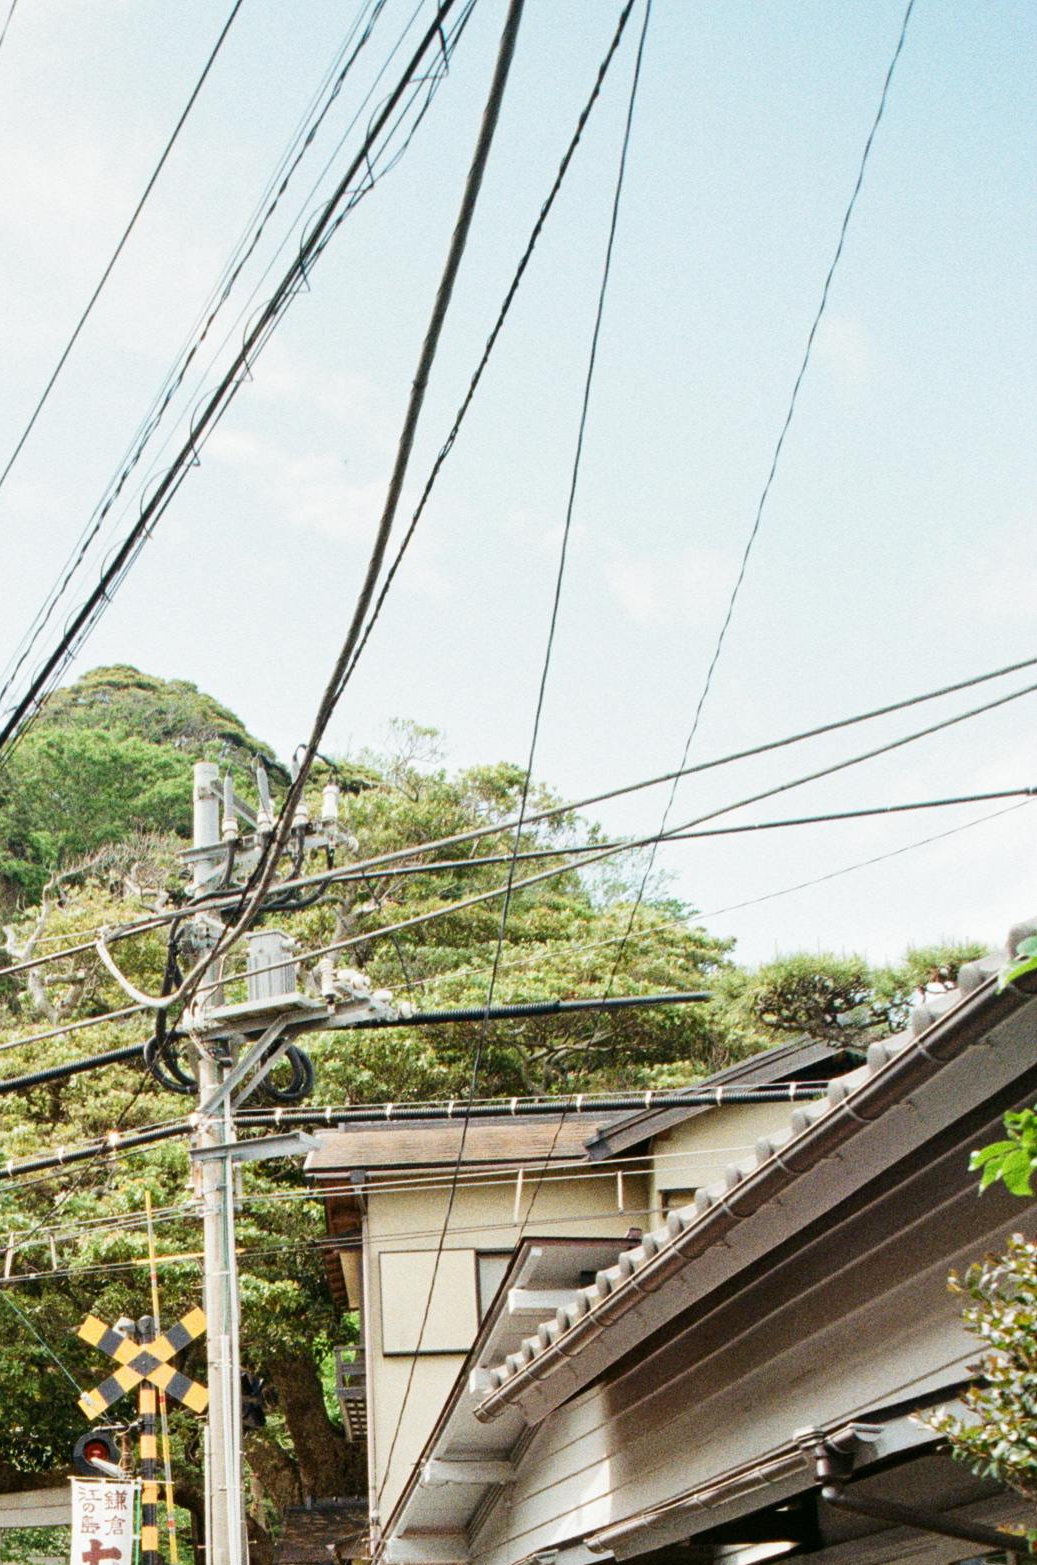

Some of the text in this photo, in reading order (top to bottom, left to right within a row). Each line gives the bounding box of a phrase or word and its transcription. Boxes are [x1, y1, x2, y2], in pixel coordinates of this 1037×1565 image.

[78, 1486, 102, 1534] 江の島
[104, 1490, 127, 1535] 鎌倉
